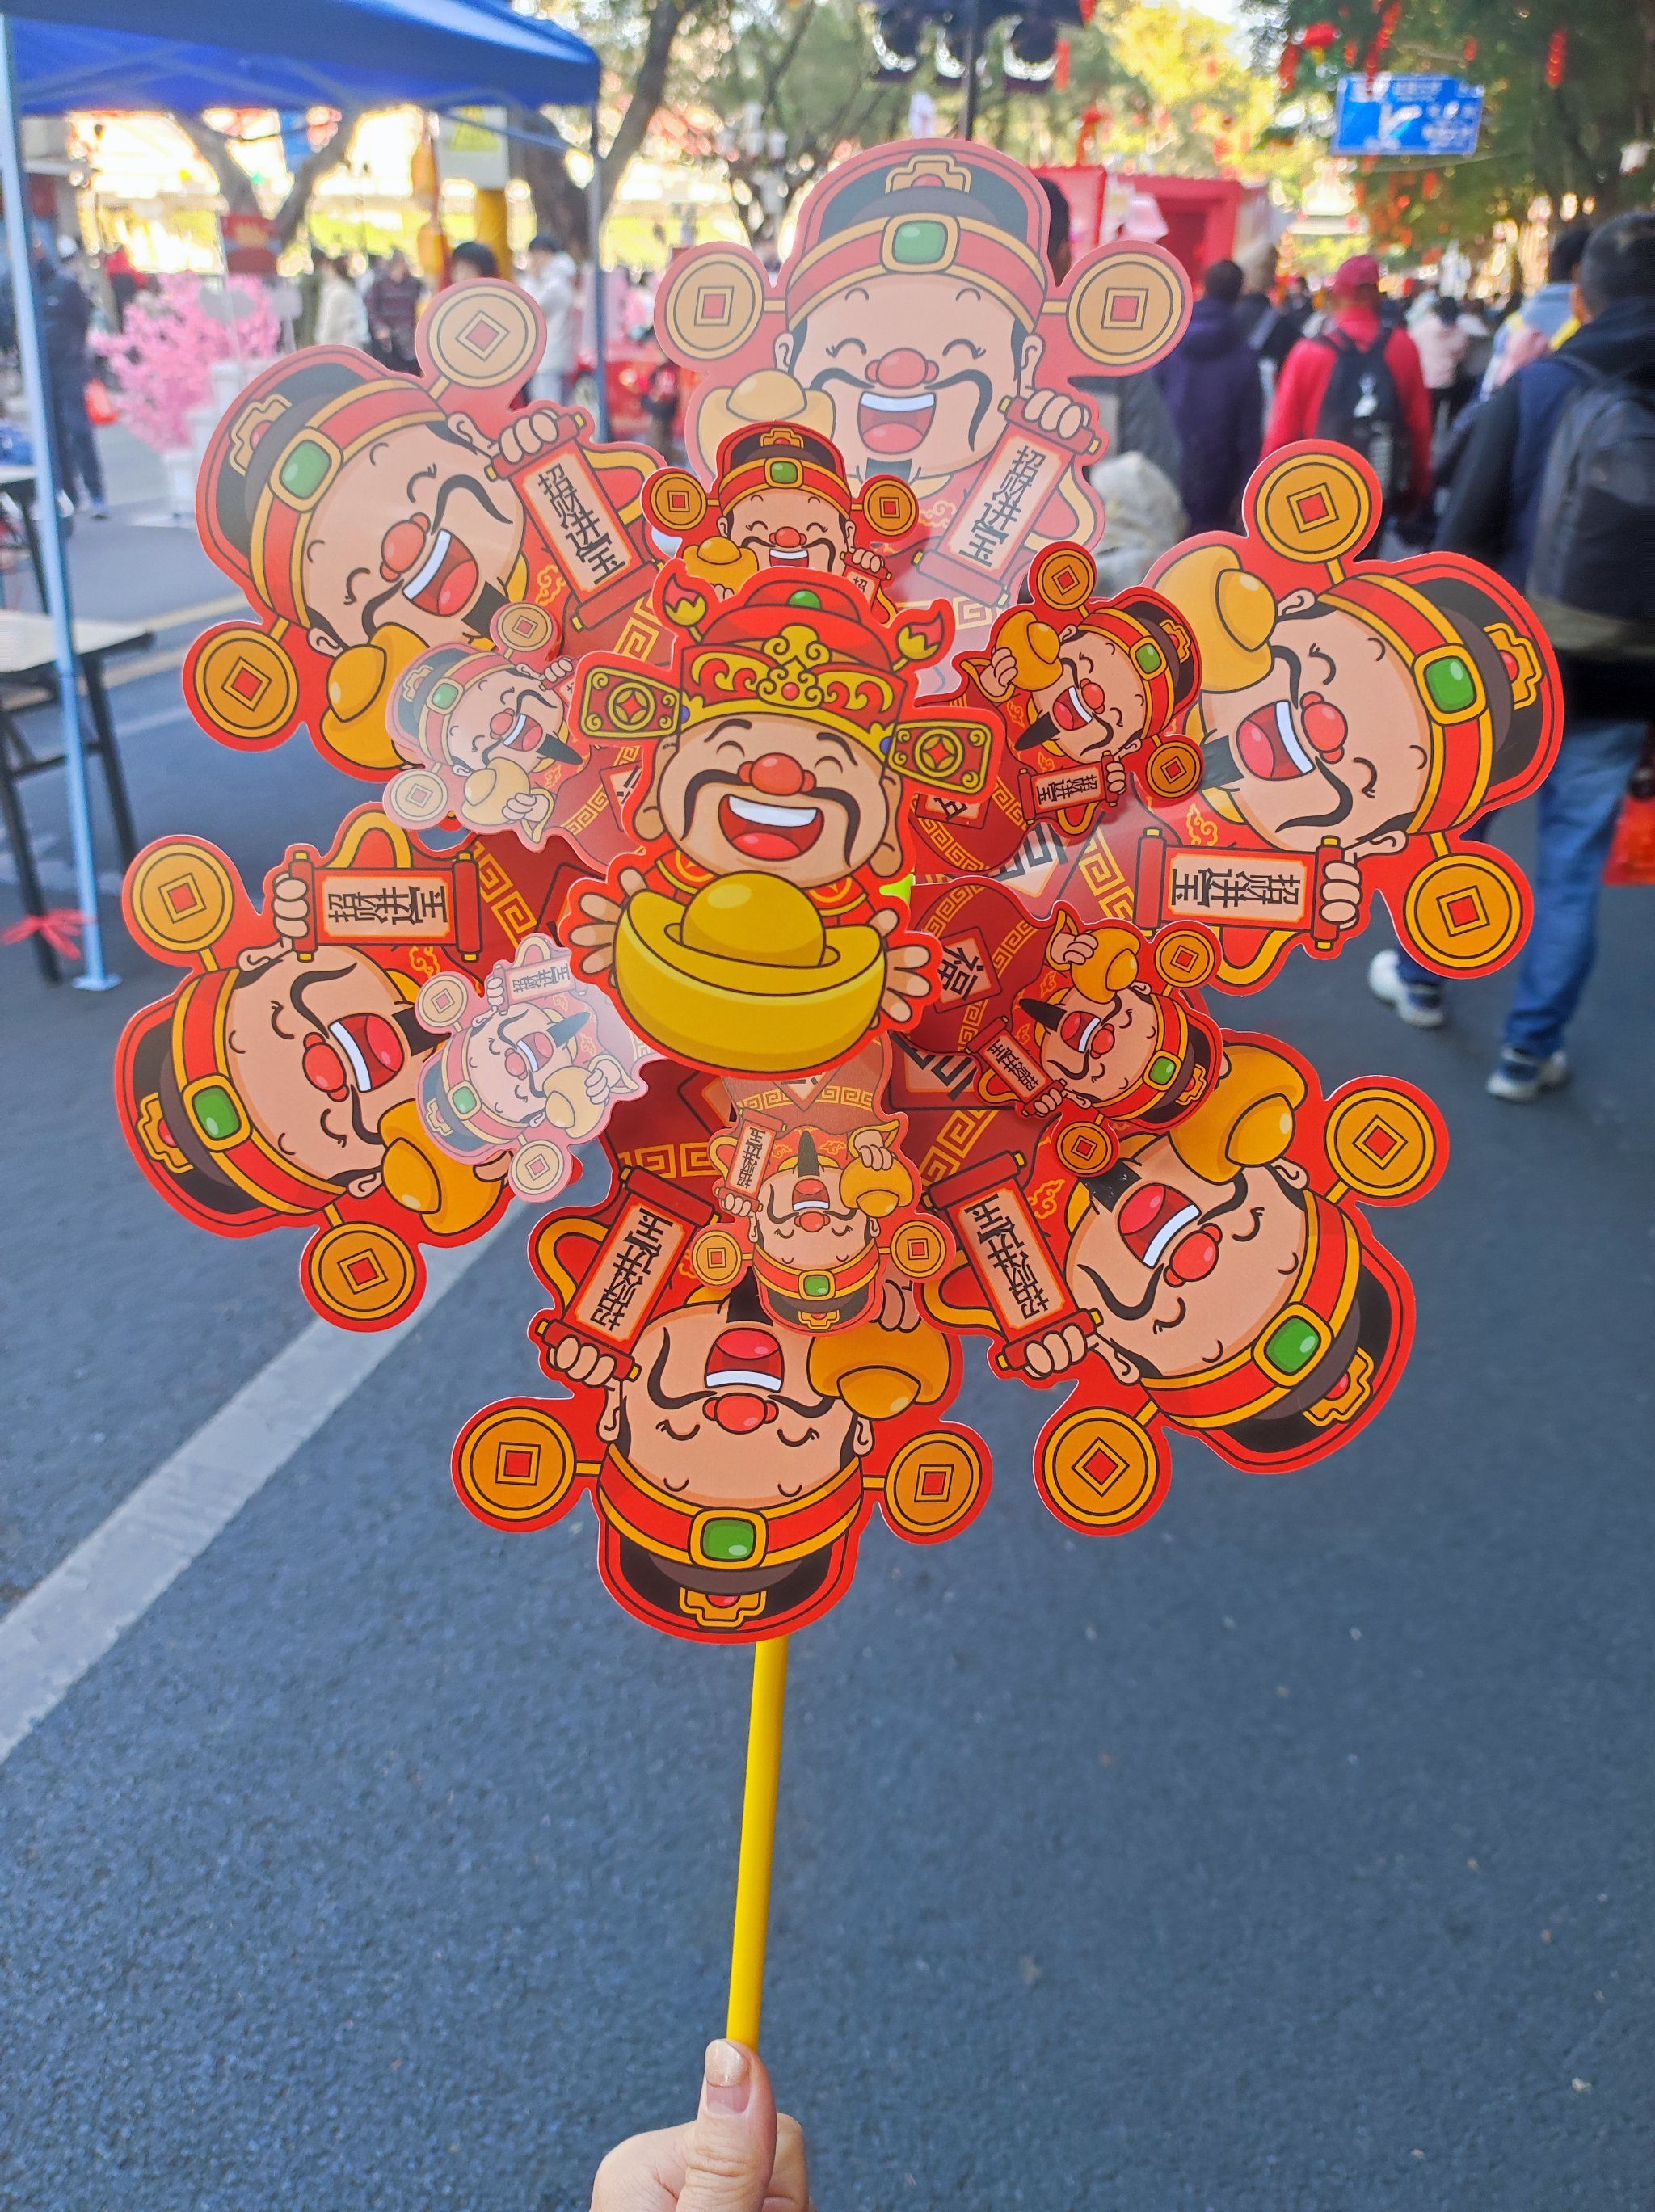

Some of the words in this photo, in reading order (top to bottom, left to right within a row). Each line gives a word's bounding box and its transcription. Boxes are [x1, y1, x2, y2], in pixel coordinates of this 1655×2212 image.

[537, 462, 626, 585] 招财进宝
[958, 445, 1046, 567] 招财进宝
[1036, 774, 1097, 805] 招财进宝
[328, 886, 448, 925] 招财进宝
[1171, 867, 1301, 908] 招财进宝
[512, 963, 571, 993] 招财进宝
[987, 1039, 1039, 1092] 招财进宝
[737, 1127, 766, 1189] 招财进宝
[590, 1207, 674, 1332] 招财进宝
[964, 1194, 1049, 1320] 招财进宝
